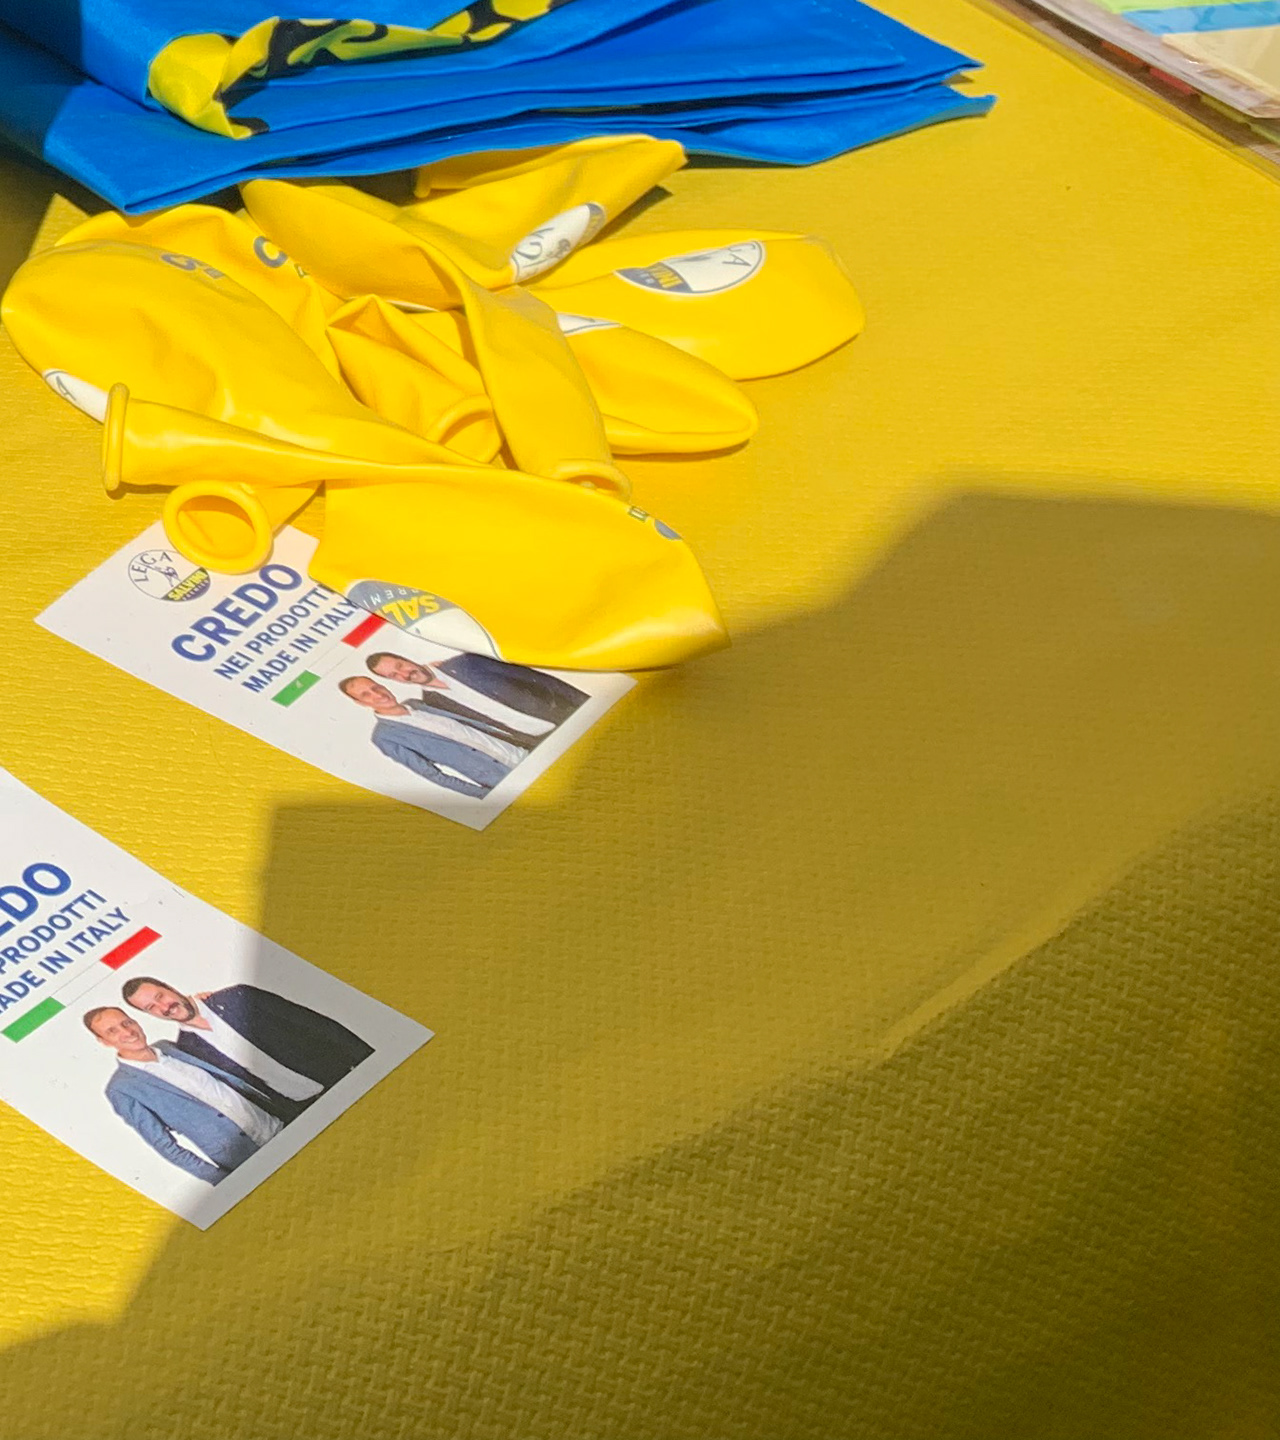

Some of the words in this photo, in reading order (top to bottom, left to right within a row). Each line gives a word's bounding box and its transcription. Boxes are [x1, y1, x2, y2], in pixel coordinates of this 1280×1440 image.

[132, 551, 173, 584] LEGA
[167, 568, 210, 602] SALVINI
[170, 563, 303, 662] CREDO
[213, 652, 251, 681] NEI
[241, 649, 299, 693] MADE
[290, 632, 319, 655] IN
[308, 599, 360, 639] ITALY
[38, 949, 75, 976] IN
[65, 906, 131, 955] ITALY
